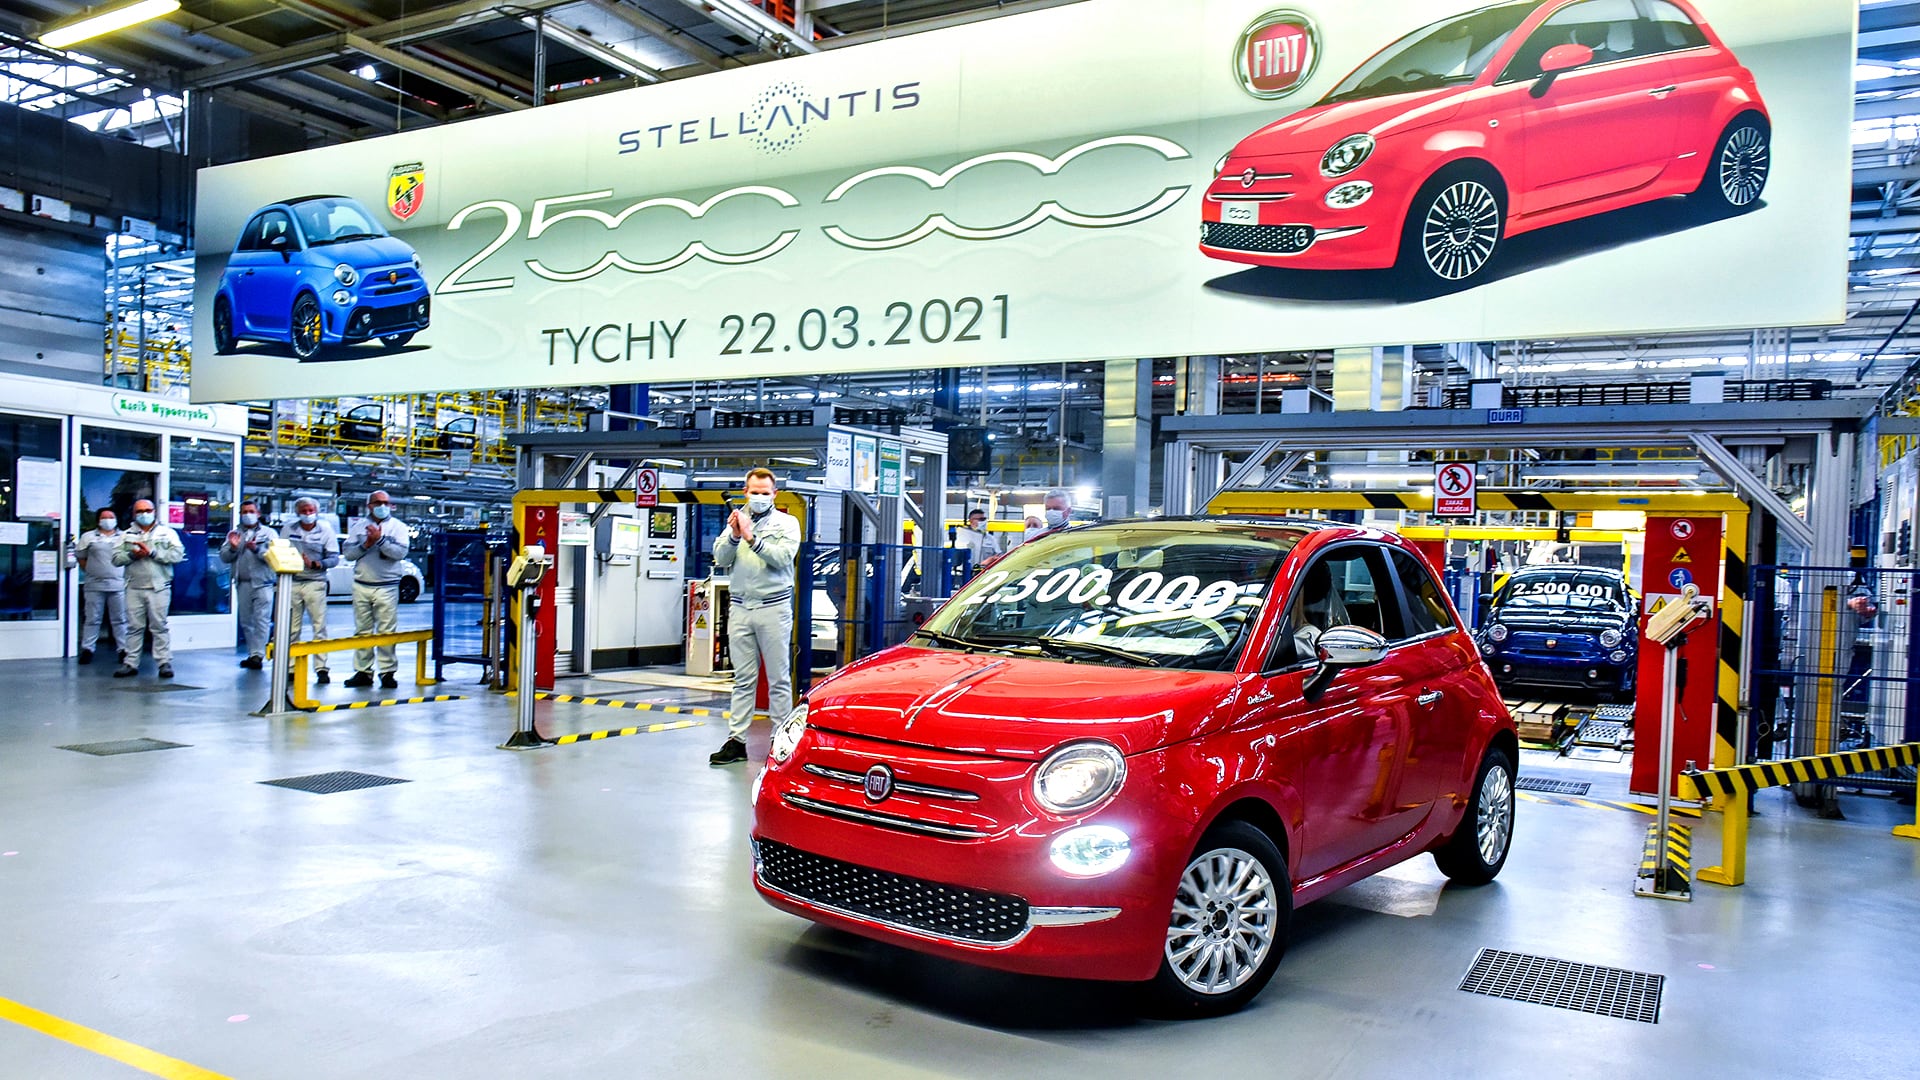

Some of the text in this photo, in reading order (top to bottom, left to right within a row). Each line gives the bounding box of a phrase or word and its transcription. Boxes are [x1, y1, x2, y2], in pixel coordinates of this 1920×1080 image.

[1253, 34, 1303, 78] FIAT
[618, 82, 921, 155] STELLANTIS
[541, 293, 1009, 366] TYCHY 22.03.2021
[961, 567, 1237, 619] 2.500.000
[1512, 582, 1613, 600] 2.500.001
[869, 775, 886, 792] FIAT
